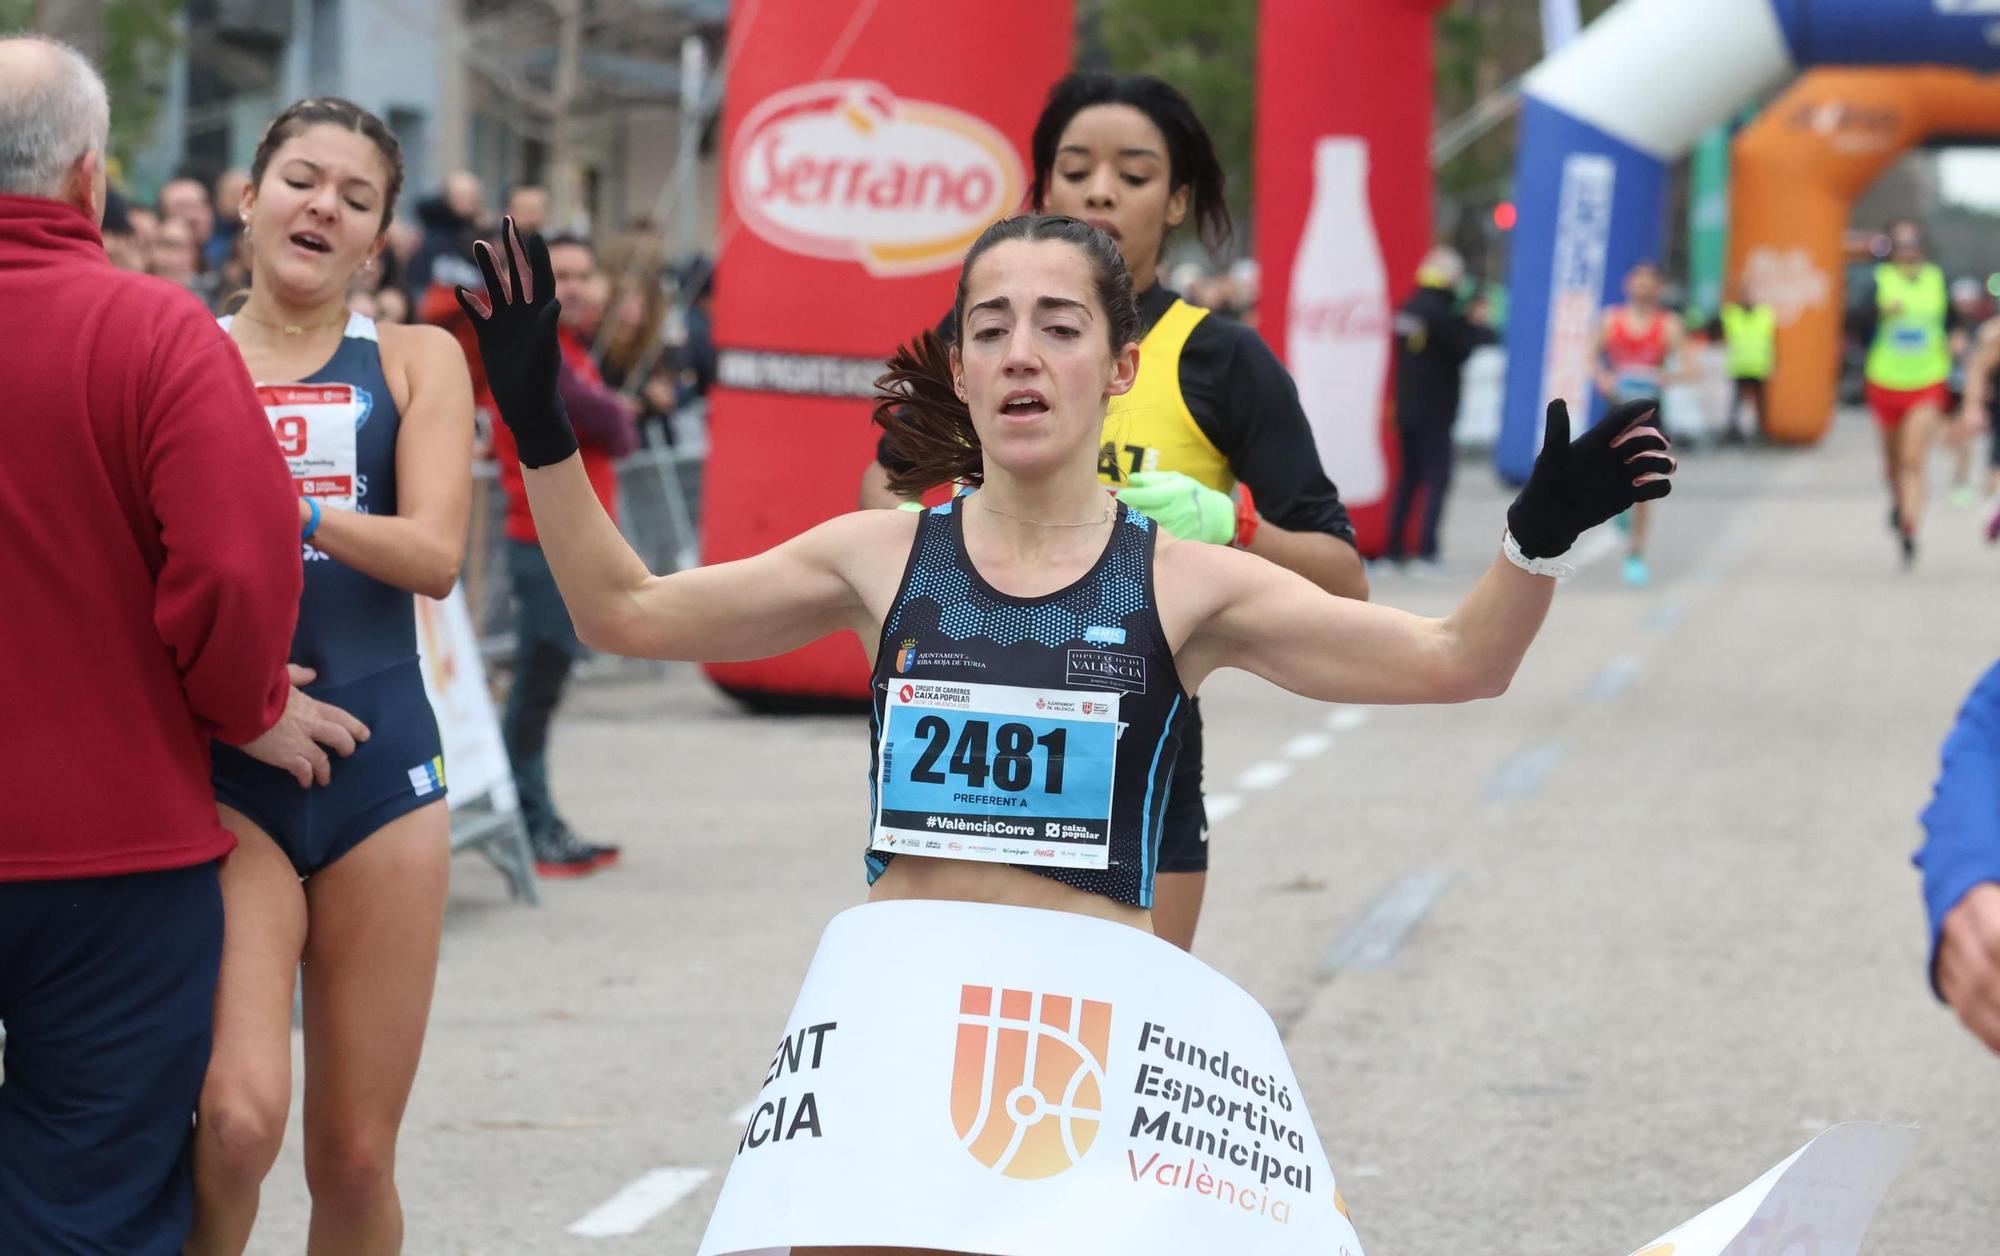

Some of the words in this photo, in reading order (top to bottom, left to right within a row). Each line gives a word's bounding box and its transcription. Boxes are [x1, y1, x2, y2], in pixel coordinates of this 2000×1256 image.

[760, 132, 994, 215] Serrano
[918, 652, 964, 660] AJUNTAMENT
[914, 692, 939, 701] CAIXA
[940, 693, 971, 703] POPULAR
[915, 684, 934, 692] CIRCUIT
[943, 687, 971, 696] CARRERES
[910, 715, 1067, 795] 2481
[953, 792, 1016, 807] PREFERENT
[1020, 799, 1028, 808] A
[926, 815, 1035, 837] #ValènciaCorre
[1061, 823, 1087, 833] caixa
[1061, 830, 1099, 841] popular
[1138, 1021, 1293, 1113] Fundació
[1134, 1063, 1304, 1153] Esportiva
[1129, 1106, 1311, 1193] Municipal
[1128, 1149, 1290, 1225] València
